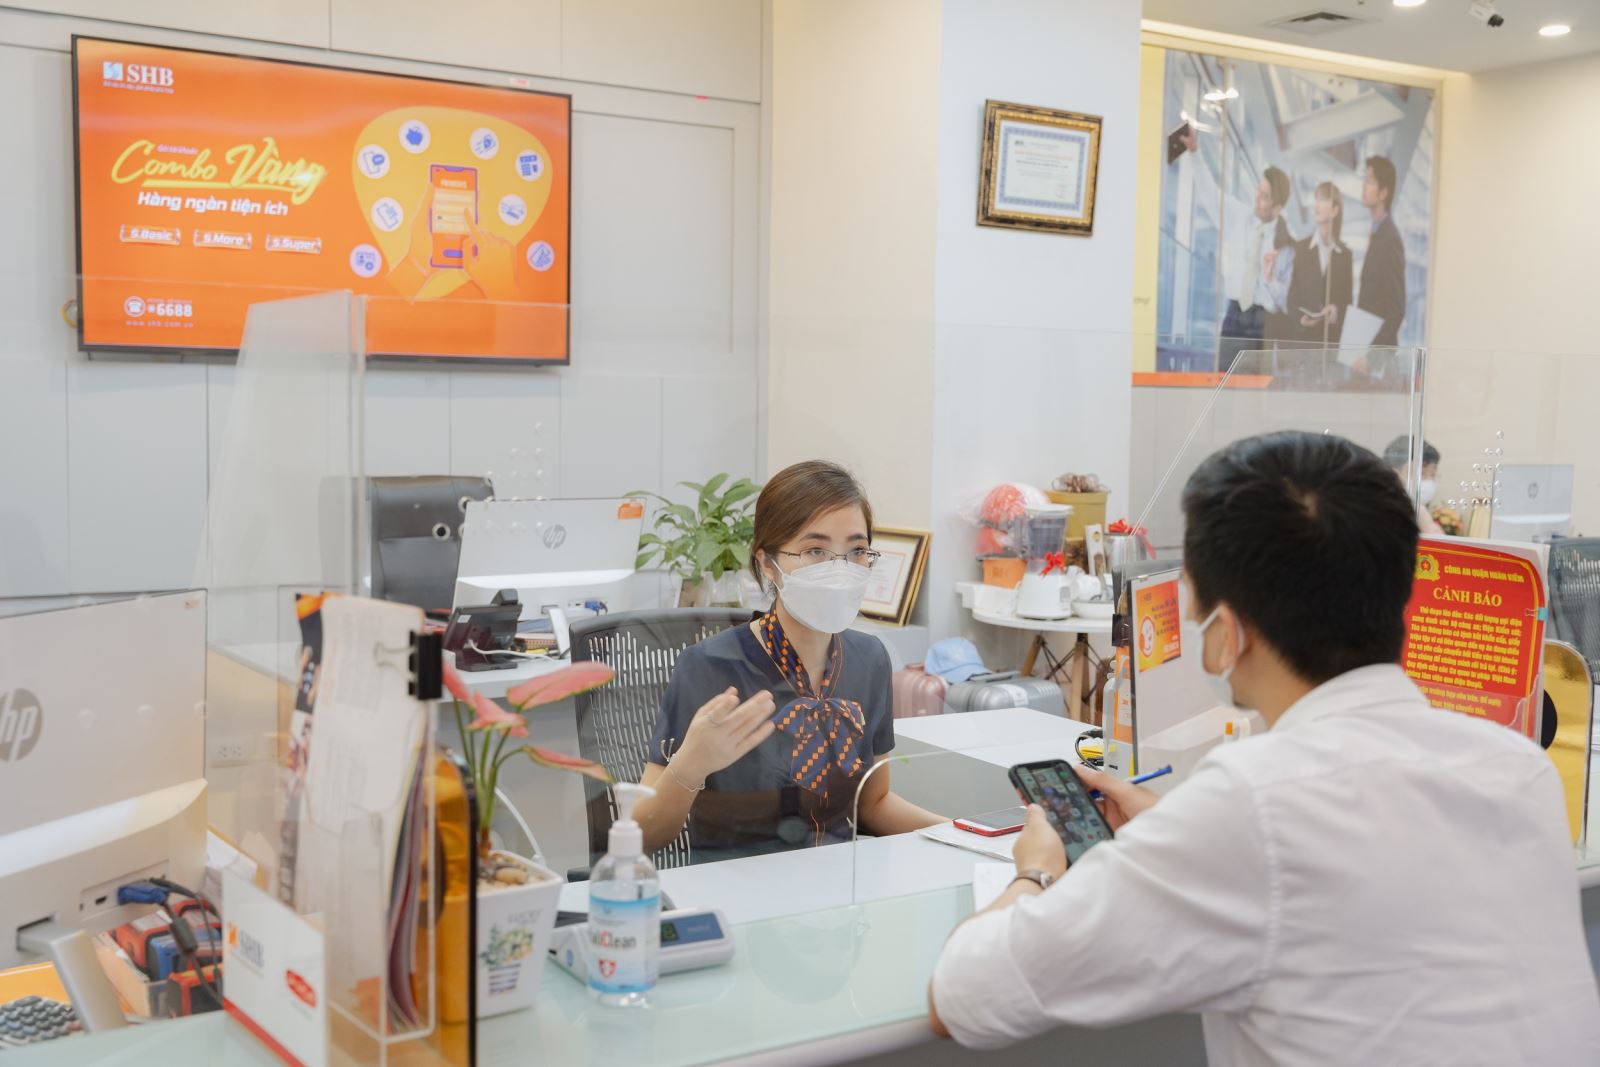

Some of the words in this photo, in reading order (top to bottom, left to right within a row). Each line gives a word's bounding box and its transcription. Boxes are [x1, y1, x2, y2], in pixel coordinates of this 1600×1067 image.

[127, 64, 174, 87] SHB
[111, 139, 218, 184] Combo
[225, 136, 326, 205] Vàng
[138, 192, 182, 211] Hàng
[185, 195, 227, 213] ngàn
[230, 198, 261, 216] tiện
[264, 200, 289, 216] ích
[544, 524, 567, 550] hp
[1433, 585, 1470, 604] CẢNH
[1473, 590, 1502, 607] BÁO
